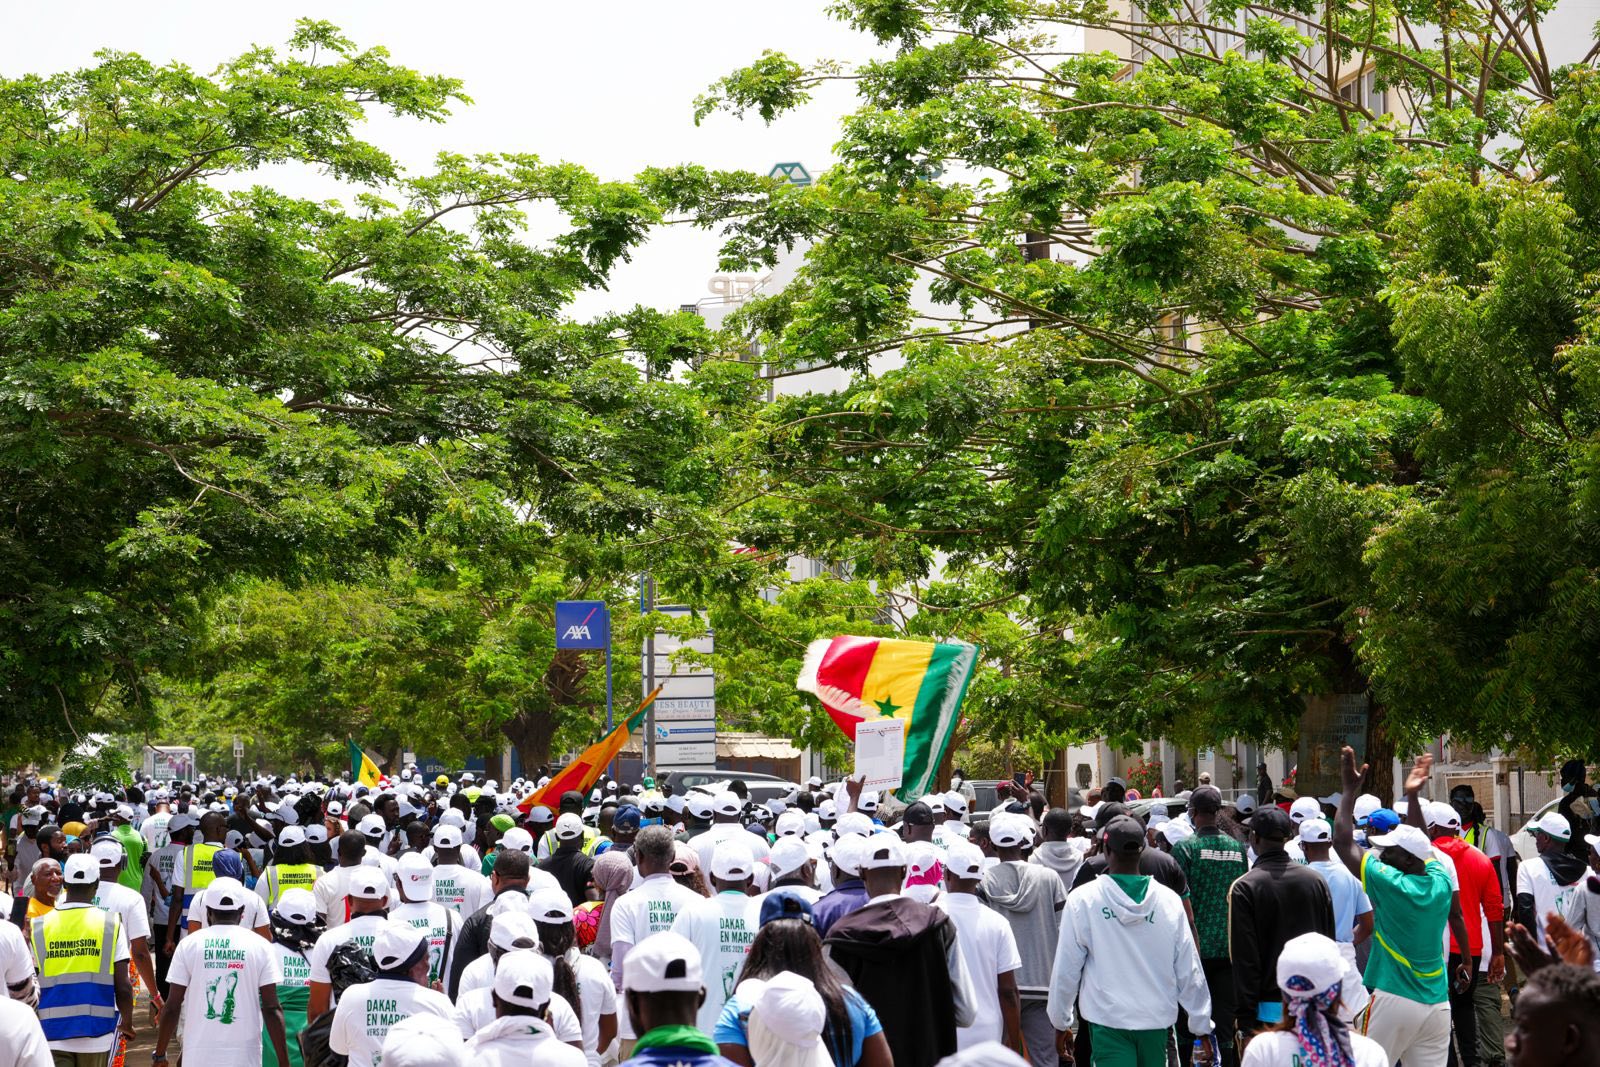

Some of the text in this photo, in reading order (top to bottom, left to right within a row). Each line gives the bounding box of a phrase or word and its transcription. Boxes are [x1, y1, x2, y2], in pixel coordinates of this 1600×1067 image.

[562, 625, 591, 640] AXA
[436, 880, 455, 888] DAKAR
[436, 888, 465, 896] EN MARCHE
[648, 901, 671, 911] DAKAR
[650, 912, 677, 923] EN MAR
[408, 919, 429, 928] AKAR
[720, 918, 745, 930] DAKAR
[351, 936, 375, 947] AKAR
[721, 931, 757, 943] EN MARC
[49, 939, 97, 949] COMMISSION
[205, 939, 230, 949] DAKAR
[204, 950, 246, 960] EN MARCHE
[204, 961, 215, 969] VERS
[216, 961, 227, 969] 2029
[284, 956, 305, 967] DAKAR
[284, 968, 311, 978] EN MARC
[367, 1000, 397, 1012] DAKAR
[367, 1014, 378, 1026] EN
[367, 1028, 380, 1036] VERS
